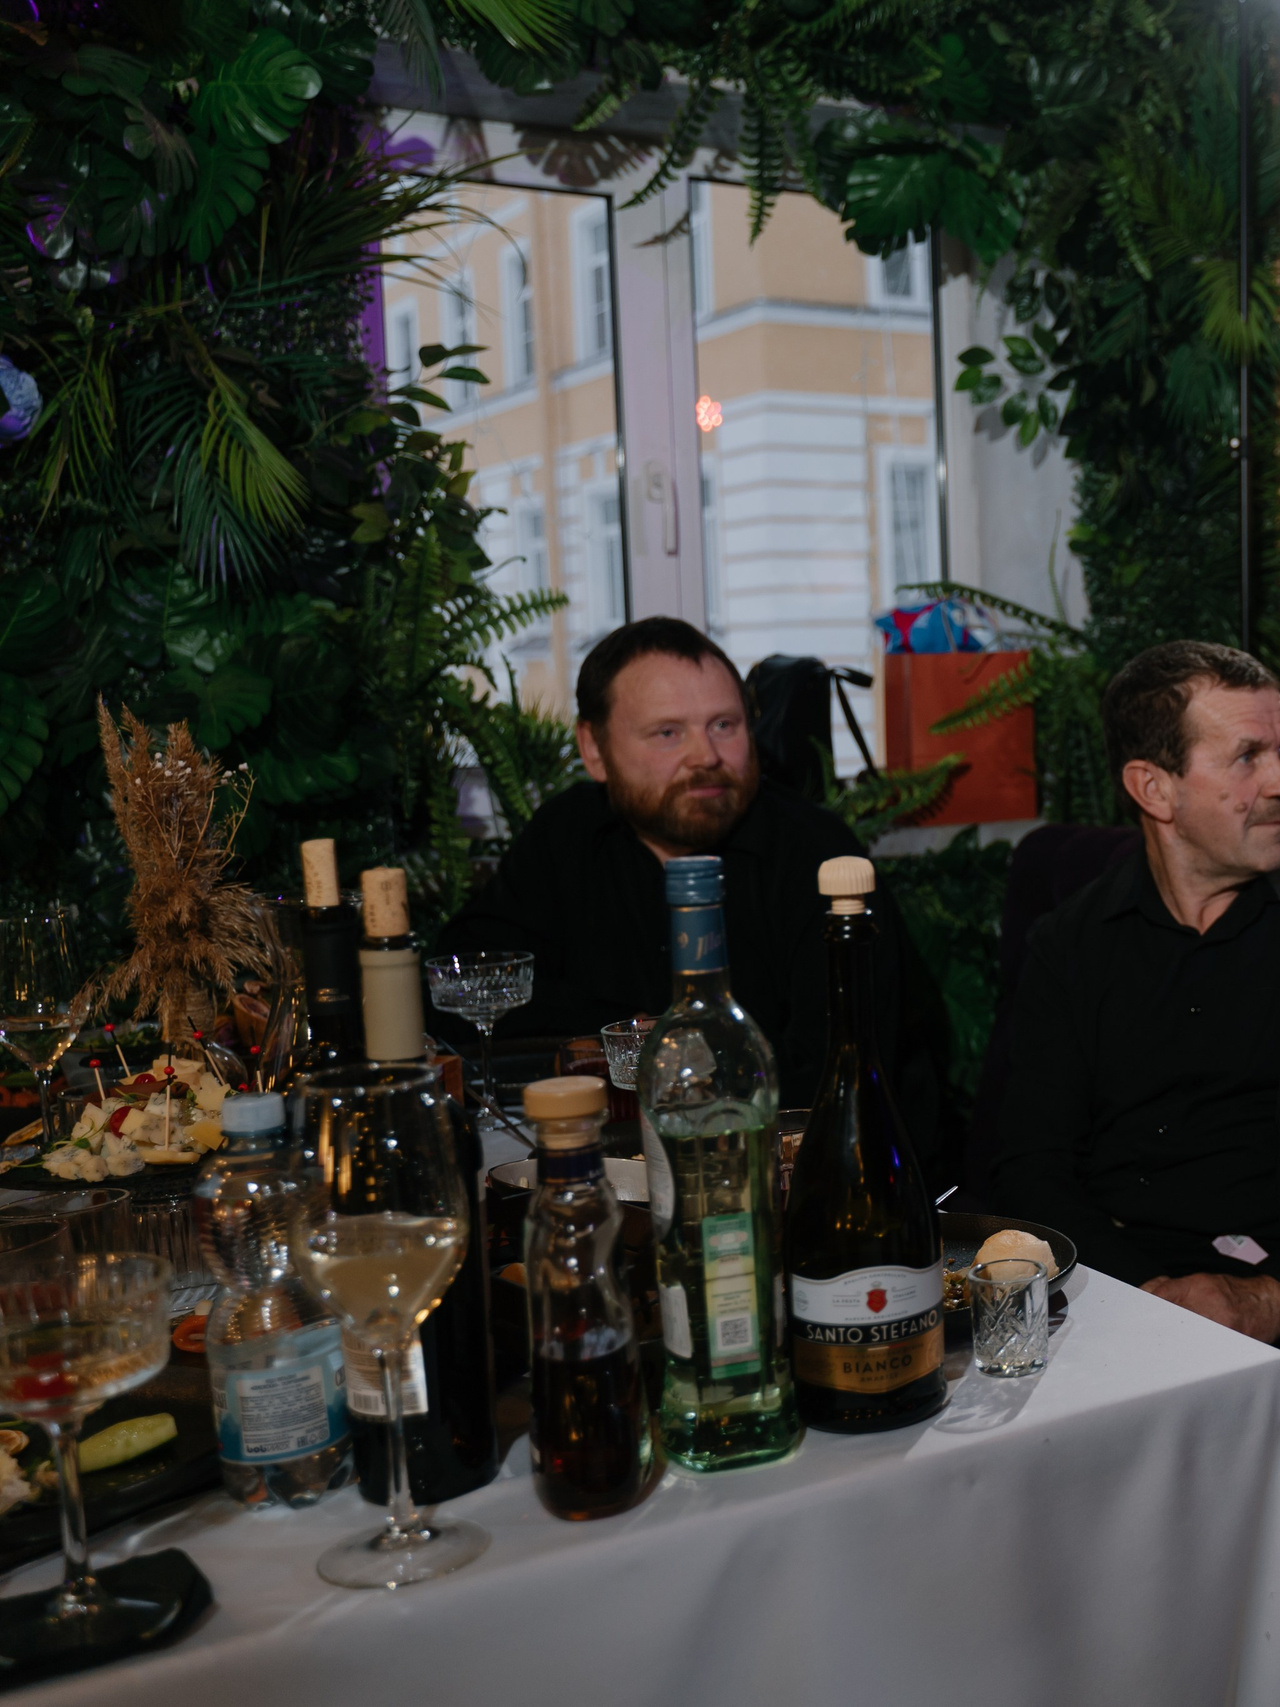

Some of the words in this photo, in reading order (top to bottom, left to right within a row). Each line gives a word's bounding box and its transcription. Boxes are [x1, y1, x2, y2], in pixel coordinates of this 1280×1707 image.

[806, 1324, 863, 1343] SANTO
[870, 1309, 938, 1342] STEFANO
[842, 1354, 913, 1374] BIANCO
